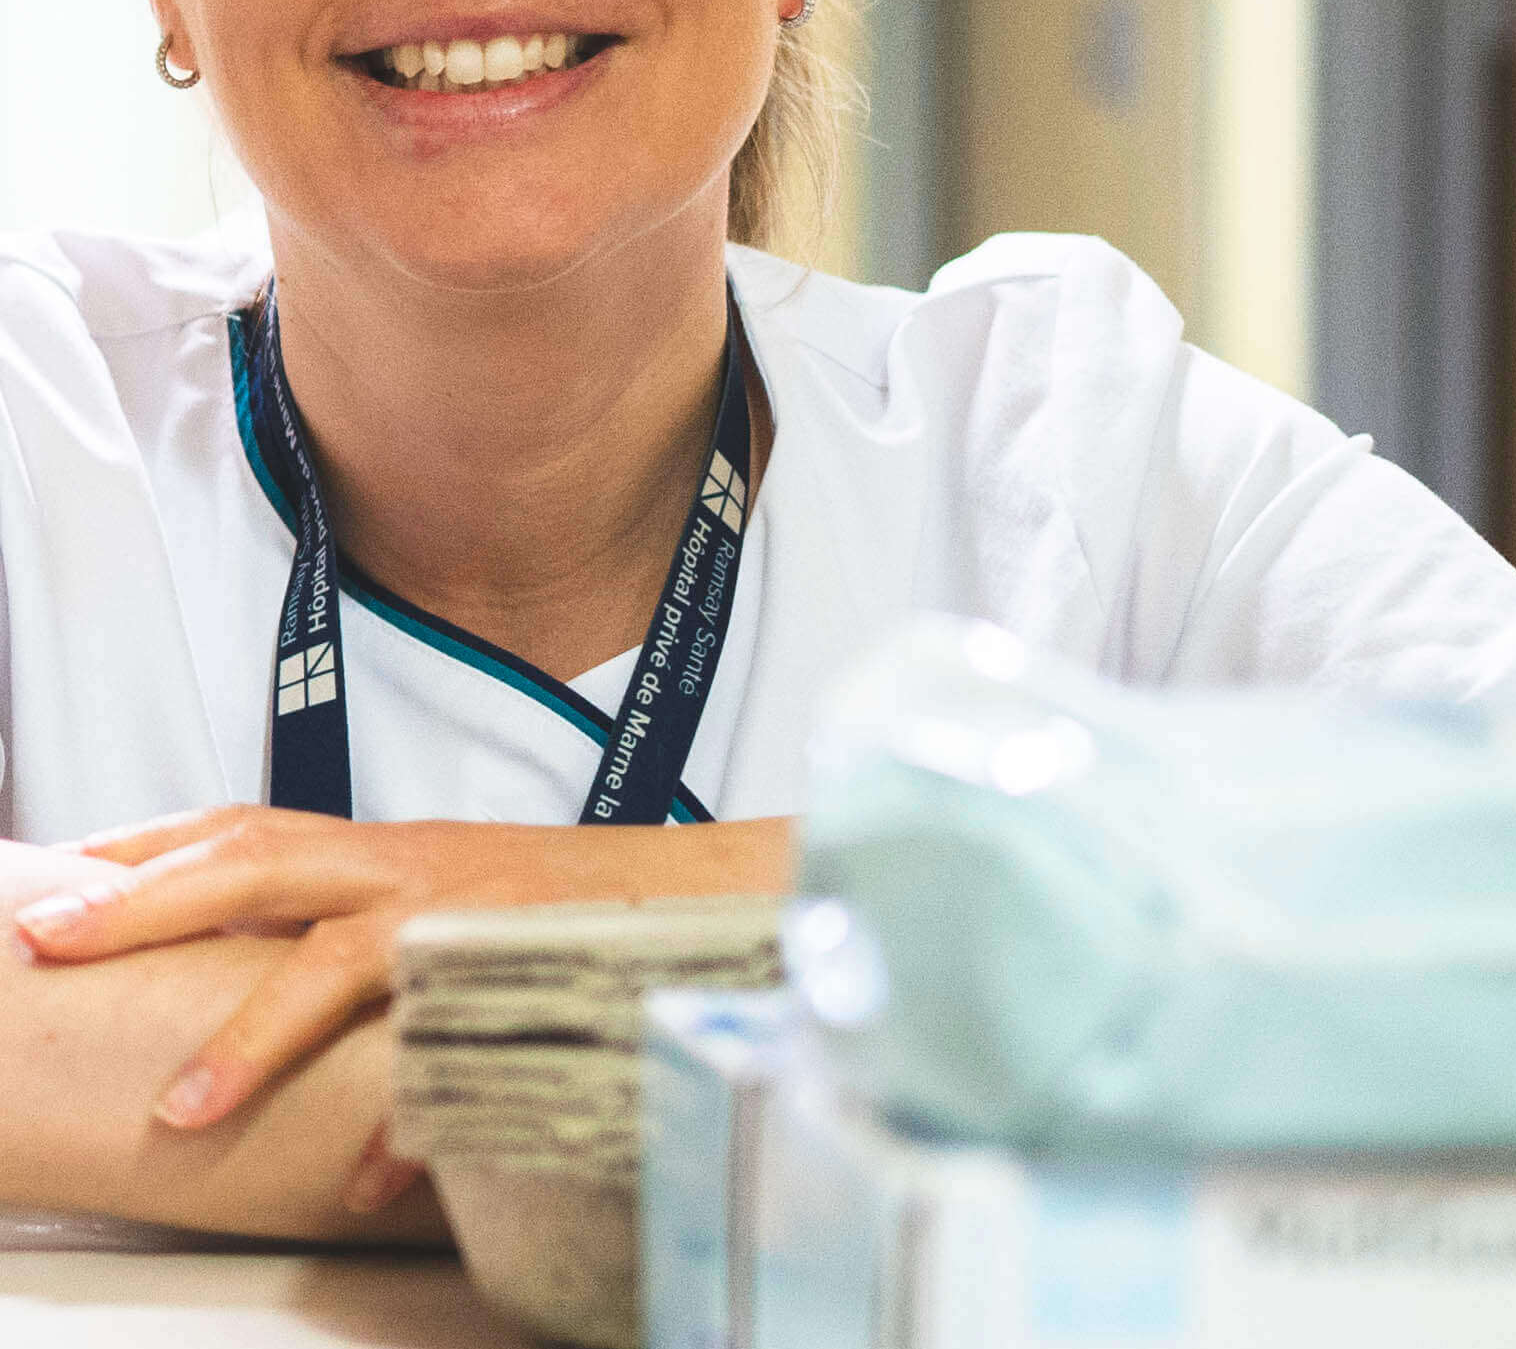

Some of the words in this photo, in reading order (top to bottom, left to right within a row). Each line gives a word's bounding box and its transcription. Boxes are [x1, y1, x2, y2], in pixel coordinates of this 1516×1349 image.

[273, 373, 298, 450] Marne
[296, 449, 311, 480] de
[308, 545, 331, 634] Hôpital
[674, 516, 713, 606] Hôpital
[698, 537, 736, 627] Ramsay
[280, 560, 310, 648] Ramsay
[650, 601, 683, 671] privé
[636, 672, 662, 705] de
[678, 628, 717, 697] Santé
[605, 708, 652, 789] Marne
[593, 793, 621, 819] la
